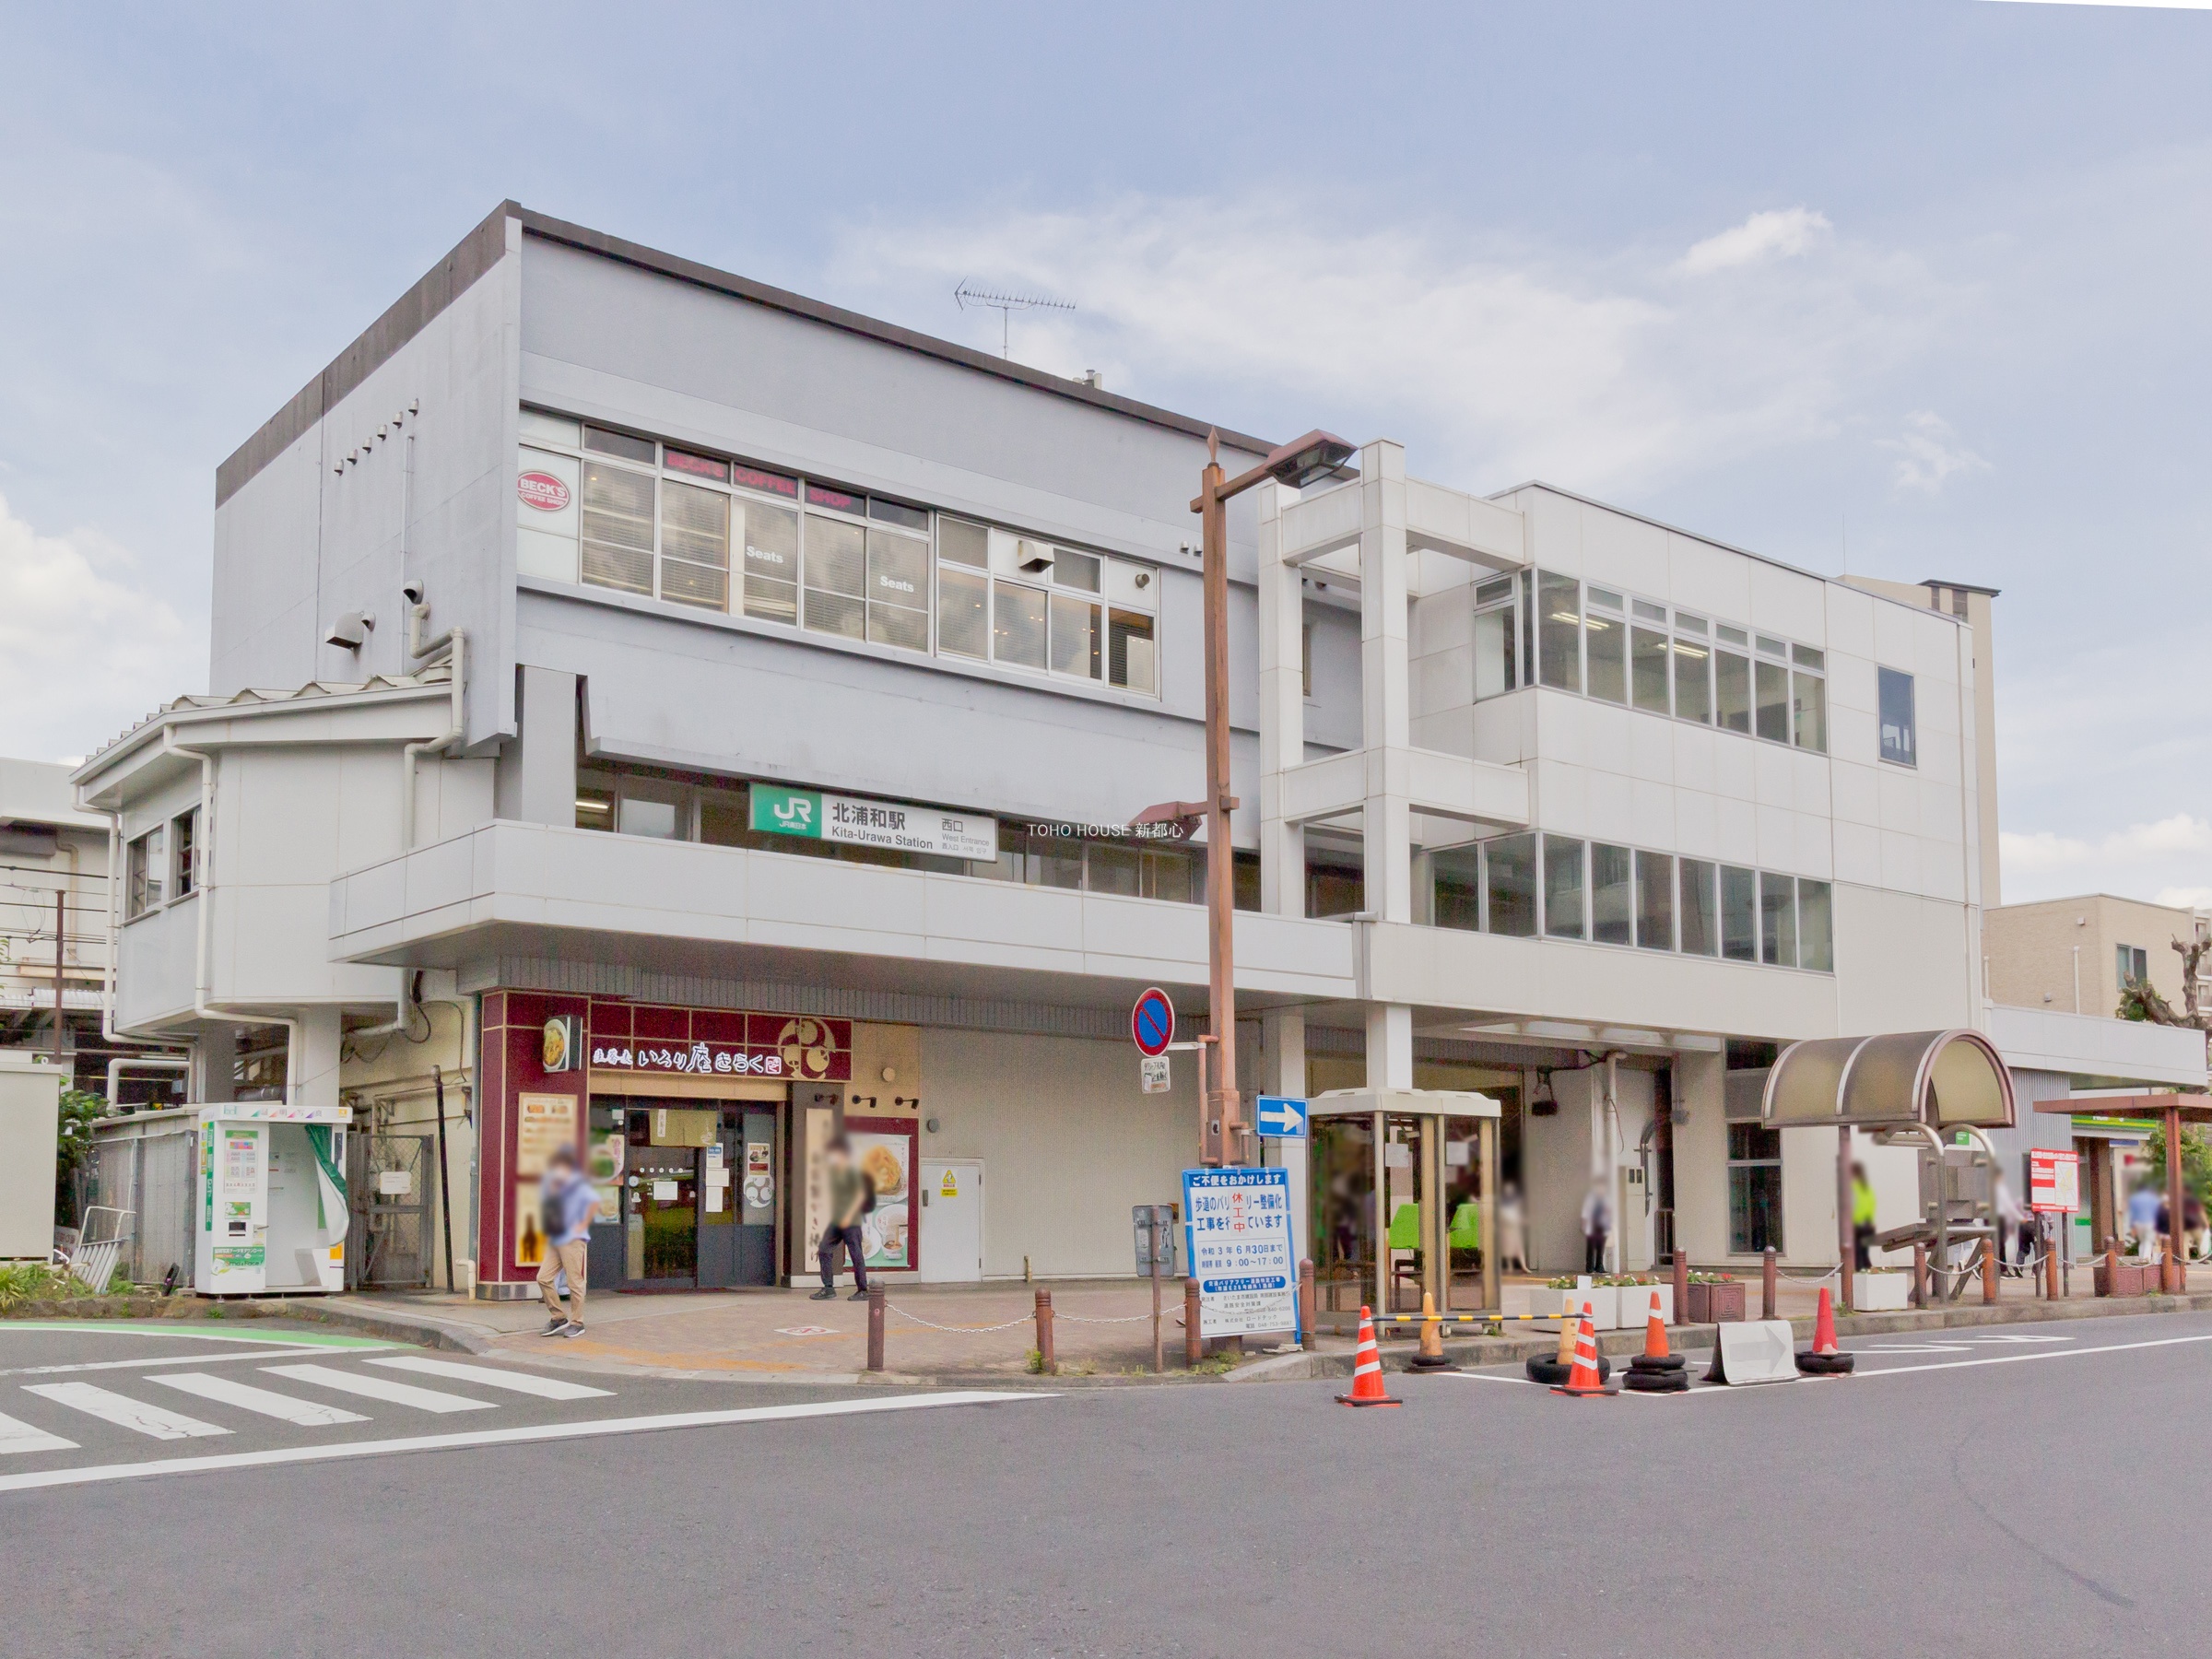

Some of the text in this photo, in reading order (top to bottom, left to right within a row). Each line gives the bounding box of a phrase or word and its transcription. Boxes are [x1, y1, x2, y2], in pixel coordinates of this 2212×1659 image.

[520, 478, 566, 497] BECK'S
[521, 491, 546, 502] COFFEE
[735, 468, 795, 495] COFFEE
[808, 488, 851, 508] SHOP
[746, 546, 783, 563] Seats
[879, 575, 914, 593] Seats
[774, 797, 811, 822] JR
[832, 802, 906, 830] 北浦和駅
[941, 818, 964, 833] 西口
[831, 826, 934, 850] Kita-Urawa Station
[942, 833, 990, 847] West Entrance
[1193, 1174, 1281, 1186] ご不便をおかけします
[1231, 1193, 1245, 1233] 休工中
